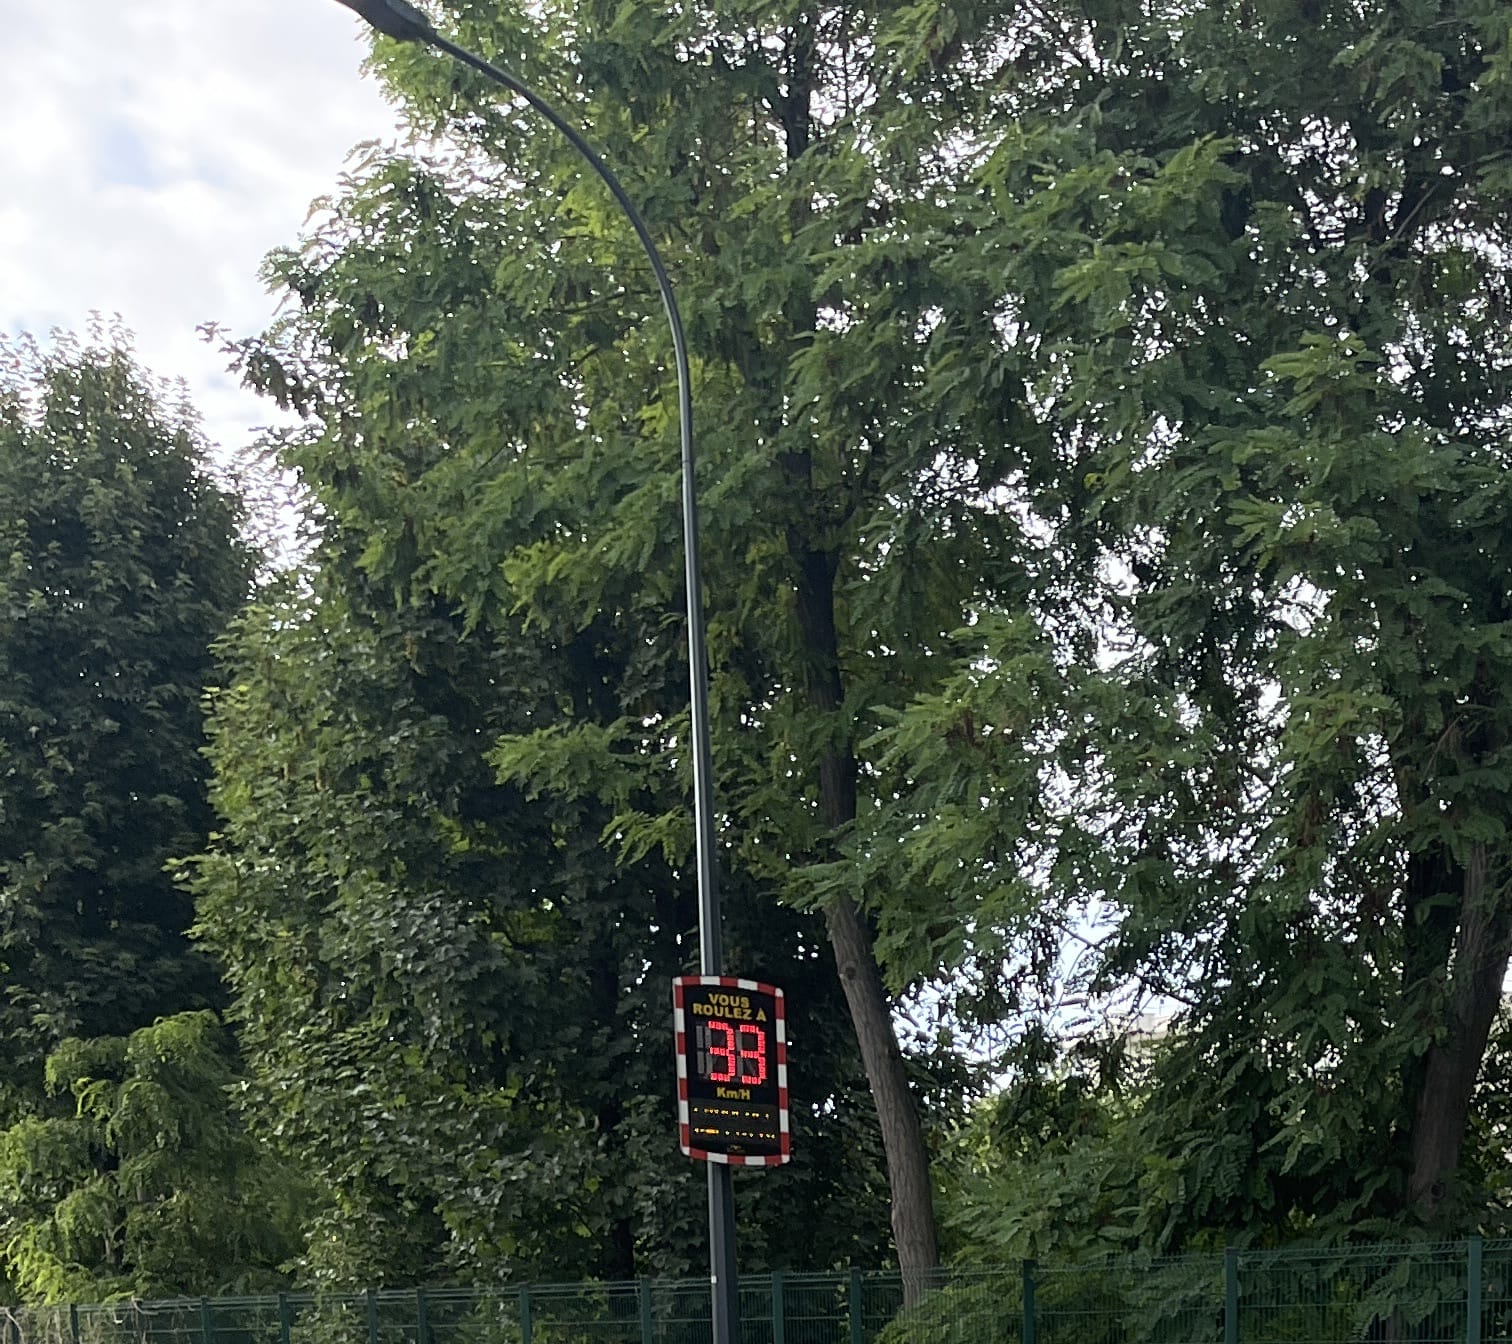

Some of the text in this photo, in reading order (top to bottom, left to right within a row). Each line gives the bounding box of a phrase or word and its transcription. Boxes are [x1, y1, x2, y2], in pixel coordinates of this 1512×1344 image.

[708, 993, 749, 1008] VOUS
[692, 1003, 752, 1020] ROULEZ
[708, 1021, 767, 1084] 33
[716, 1087, 751, 1100] Km/H
